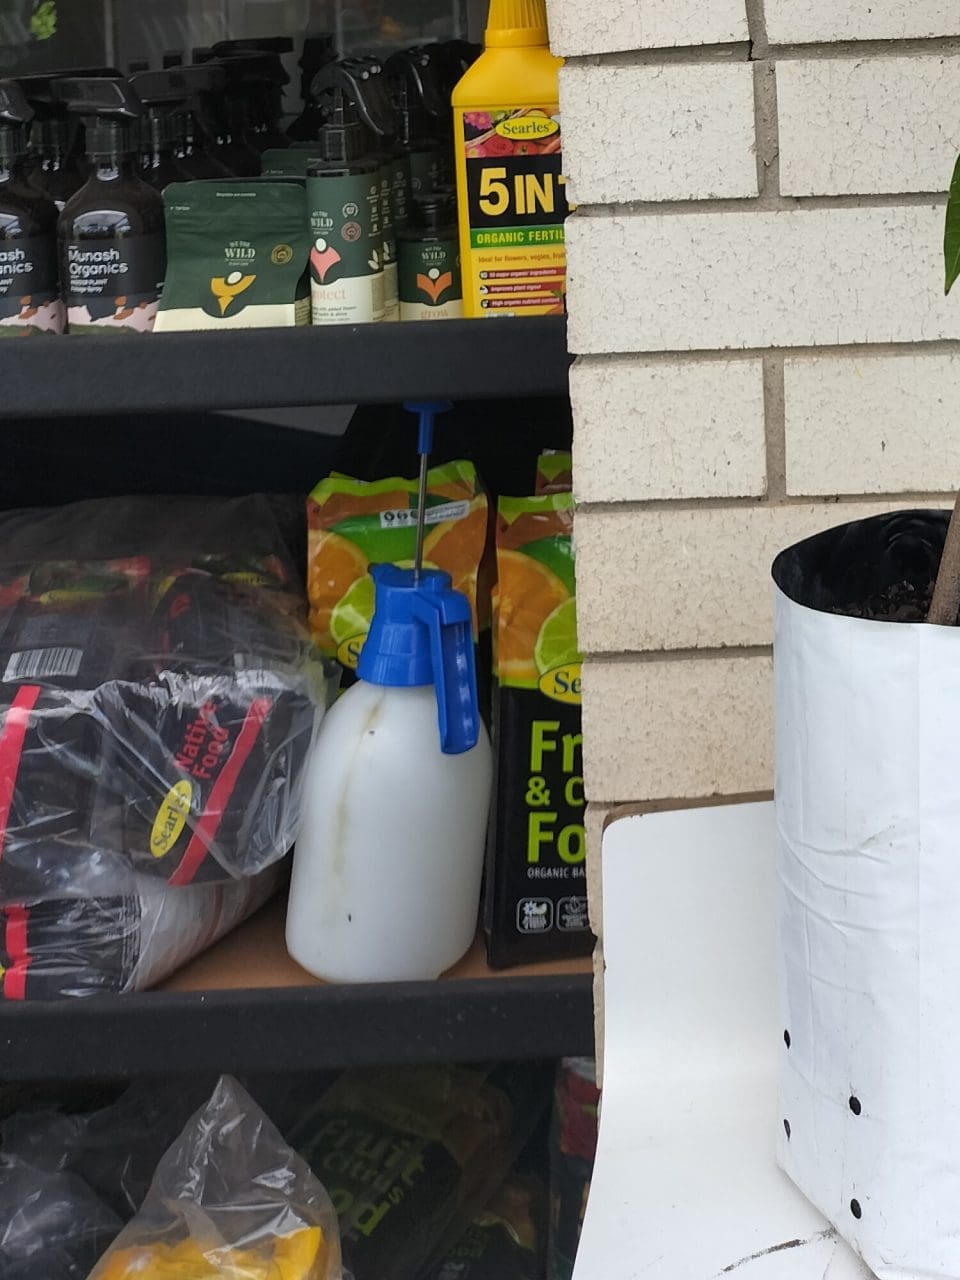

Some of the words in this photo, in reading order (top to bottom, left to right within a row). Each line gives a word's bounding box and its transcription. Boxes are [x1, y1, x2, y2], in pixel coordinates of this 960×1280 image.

[478, 167, 510, 216] 5
[514, 173, 554, 215] IN
[476, 231, 525, 244] ORGANIC
[68, 248, 120, 262] Munash
[224, 248, 256, 258] WILD
[421, 251, 446, 260] WILD
[69, 261, 129, 278] Organics
[191, 726, 230, 779] Food
[525, 775, 550, 806] &
[527, 867, 569, 879] ORGANIC
